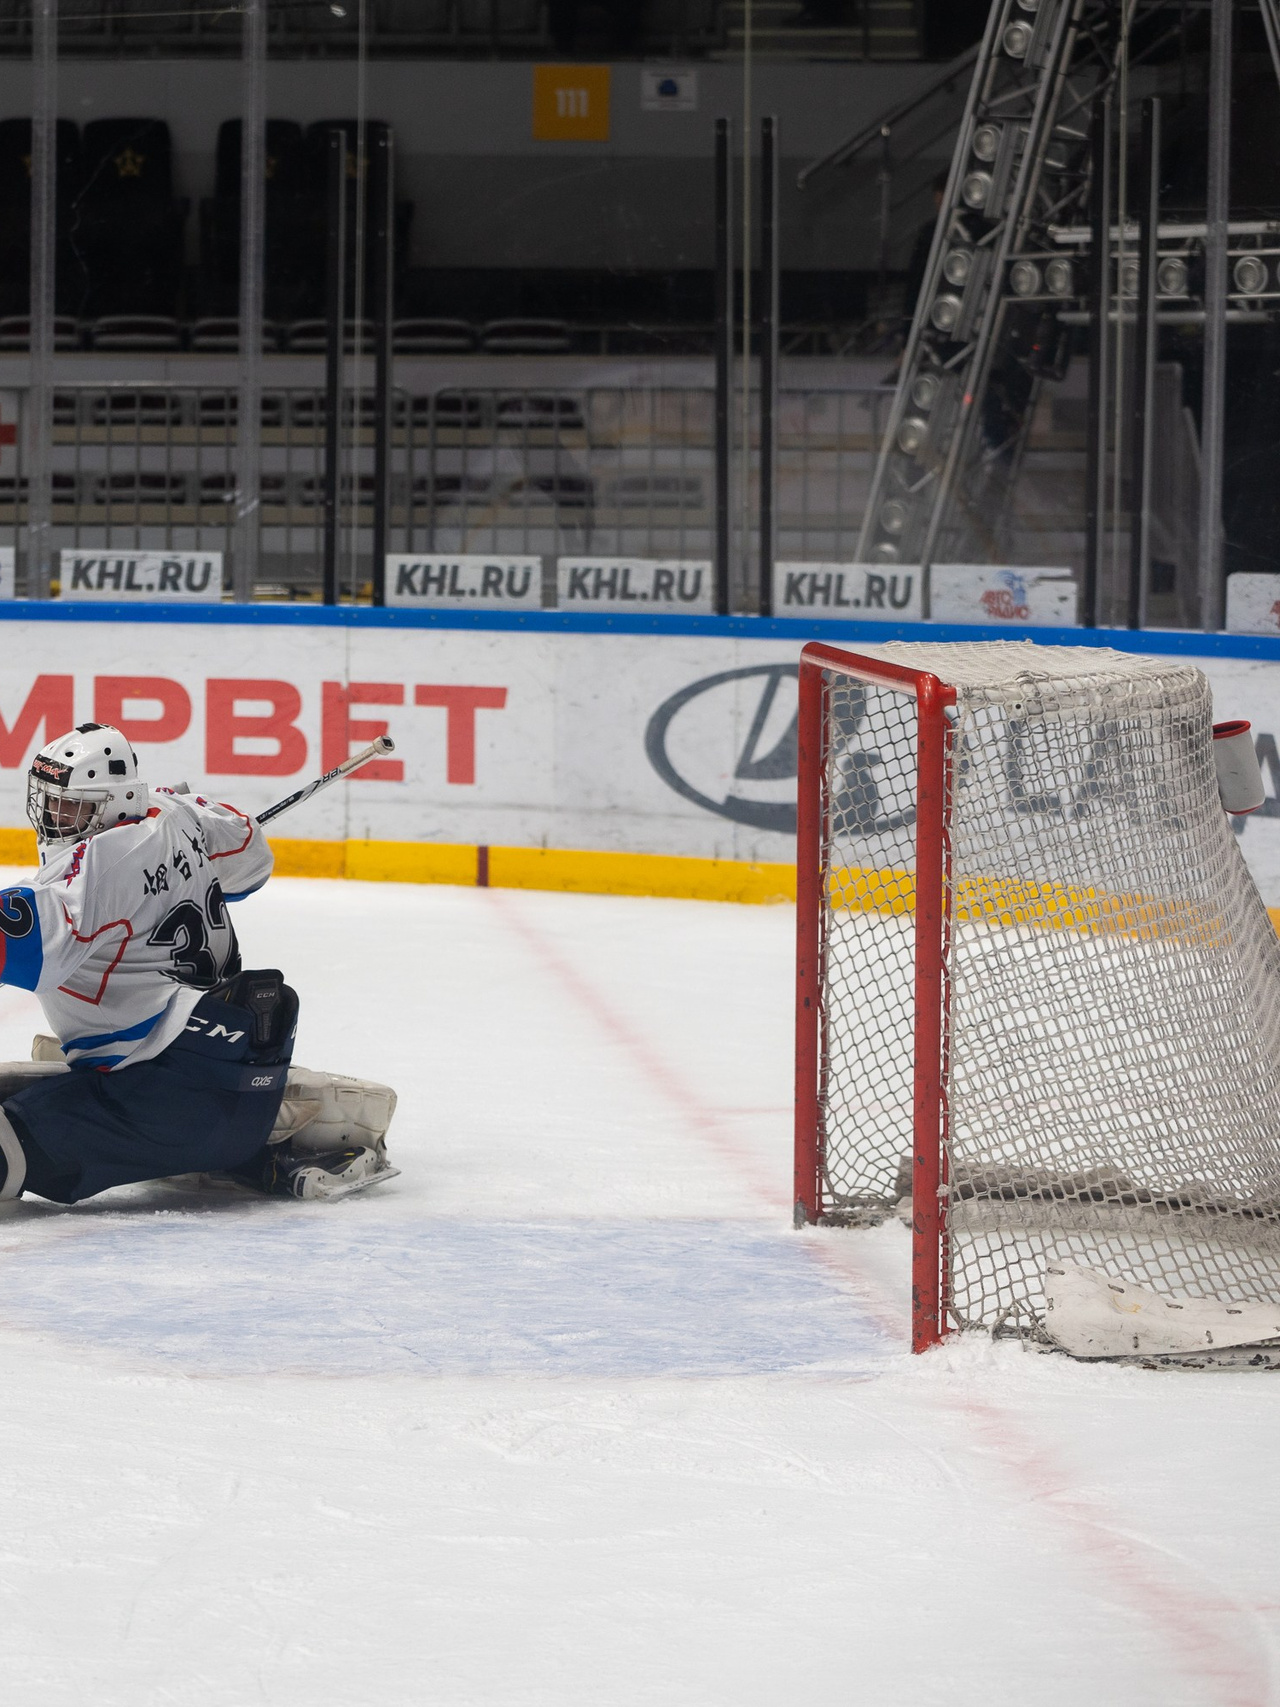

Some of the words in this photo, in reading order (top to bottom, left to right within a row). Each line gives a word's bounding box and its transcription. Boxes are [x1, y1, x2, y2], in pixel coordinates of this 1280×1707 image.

[70, 557, 213, 593] KHL.RU
[394, 563, 532, 599] KHL.RU
[567, 567, 702, 603] KHL.RU
[783, 572, 914, 611] KHL.RU
[256, 991, 276, 999] CCM
[185, 1015, 246, 1043] CM
